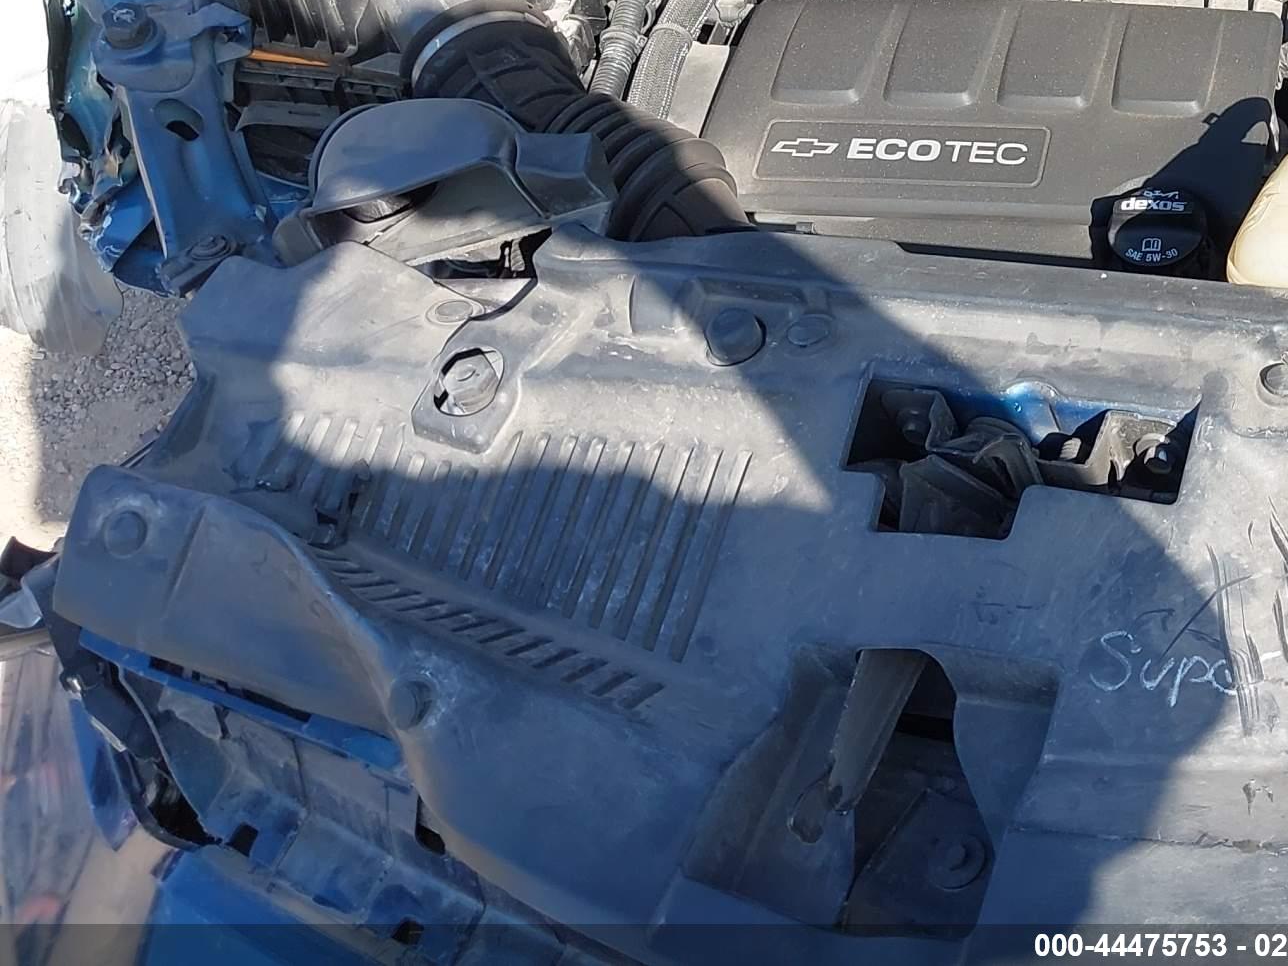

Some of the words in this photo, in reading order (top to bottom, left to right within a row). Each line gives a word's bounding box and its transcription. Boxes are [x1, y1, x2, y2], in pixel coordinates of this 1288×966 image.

[847, 137, 1028, 165] ECOTEC
[1120, 197, 1186, 212] dexos
[1125, 247, 1143, 262] SAE
[1145, 247, 1178, 263] 5W-30
